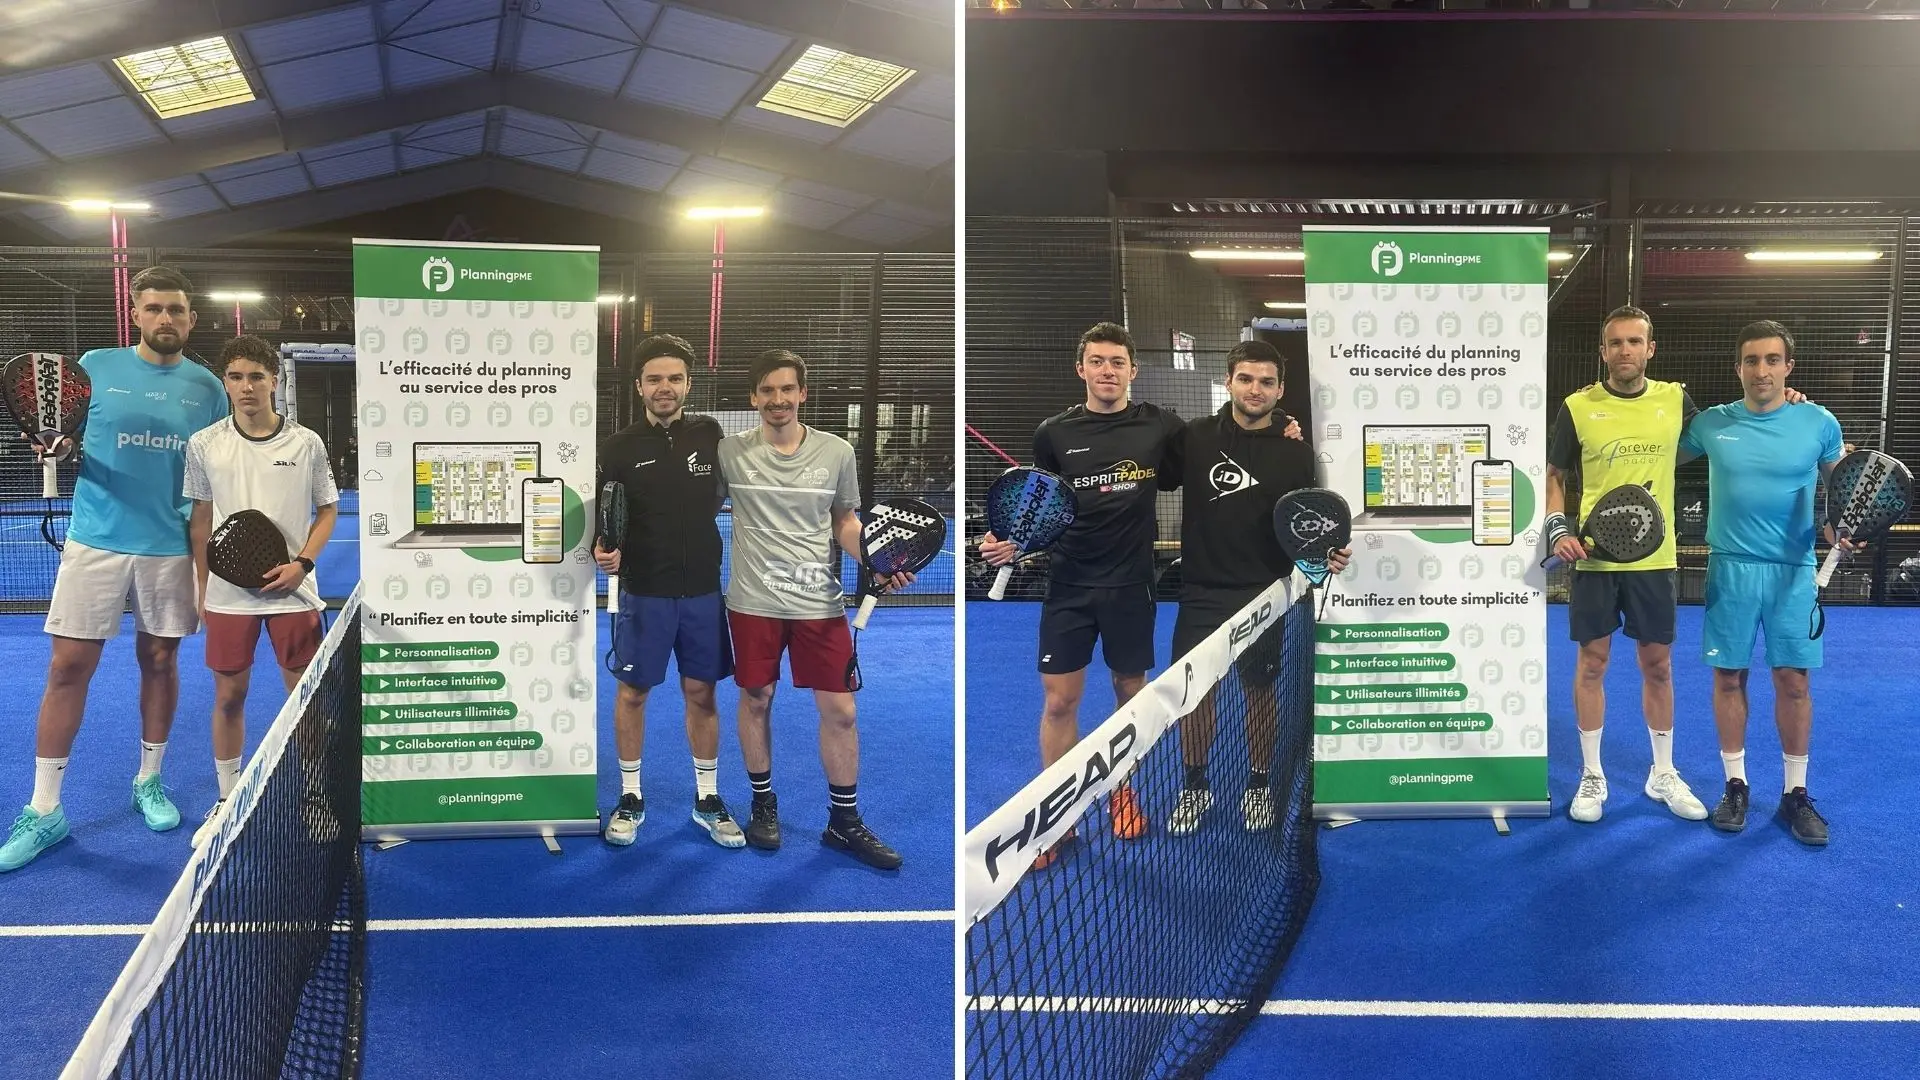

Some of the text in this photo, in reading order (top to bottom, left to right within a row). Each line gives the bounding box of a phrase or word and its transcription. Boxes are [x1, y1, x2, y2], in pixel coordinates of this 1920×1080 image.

[1330, 344, 1521, 363] L'efficacité du planning
[379, 361, 571, 380] L'efficacité du planning
[1350, 362, 1507, 381] au service des pros
[400, 380, 557, 398] au service des pros
[693, 463, 712, 473] Face
[1331, 594, 1394, 607] Planifiez
[1398, 597, 1415, 606] en
[1419, 595, 1457, 606] toute
[1461, 593, 1529, 608] simplicité
[381, 612, 444, 626] Planifiez
[448, 615, 466, 625] en
[469, 613, 507, 625] toute
[511, 611, 579, 626] simplicité
[1229, 601, 1271, 653] HEAD
[1345, 627, 1442, 639] Personnalisation
[394, 646, 492, 658] Personnalisation
[1345, 657, 1448, 668] Interface intuitive
[395, 676, 498, 688] Interface intuitive
[1346, 687, 1461, 700] Utilisateurs illimités
[395, 706, 510, 719] Utilisateurs illimités
[1346, 718, 1486, 731] Collaboration en équipe
[395, 737, 535, 750] Collaboration en équipe
[1389, 773, 1474, 787] @planningpme
[438, 792, 523, 806] @planningpme
[986, 723, 1137, 883] HEAD
